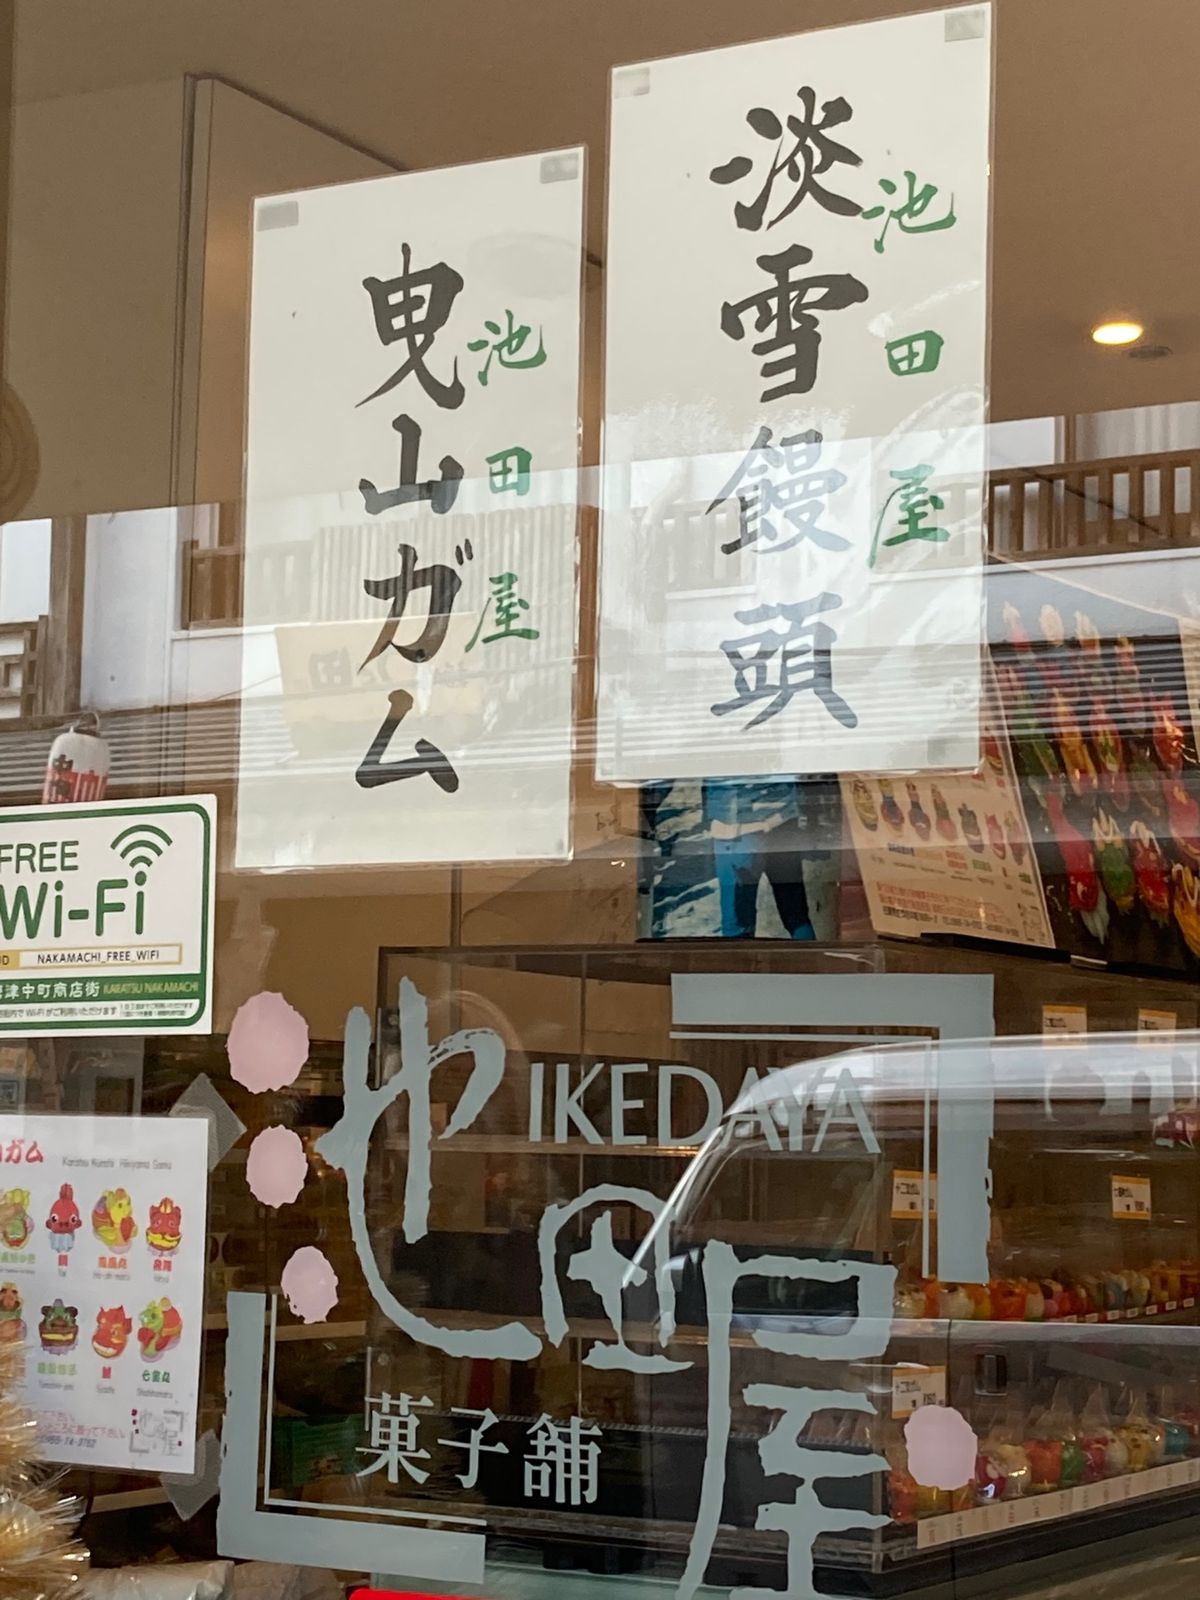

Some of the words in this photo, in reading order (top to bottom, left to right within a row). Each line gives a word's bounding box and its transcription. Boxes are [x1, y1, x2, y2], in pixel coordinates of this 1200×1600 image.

[705, 86, 868, 730] 淡雪饅頭
[862, 170, 956, 569] 池田屋
[355, 242, 473, 794] 曳山ガム
[465, 309, 547, 651] 池田屋
[0, 841, 79, 873] FREE
[0, 870, 147, 939] Wi-Fi
[37, 949, 160, 964] NAKAMACHI_FREE_WIFI
[528, 1062, 881, 1154] IKEDAYA
[355, 1392, 604, 1506] 菓子舗
